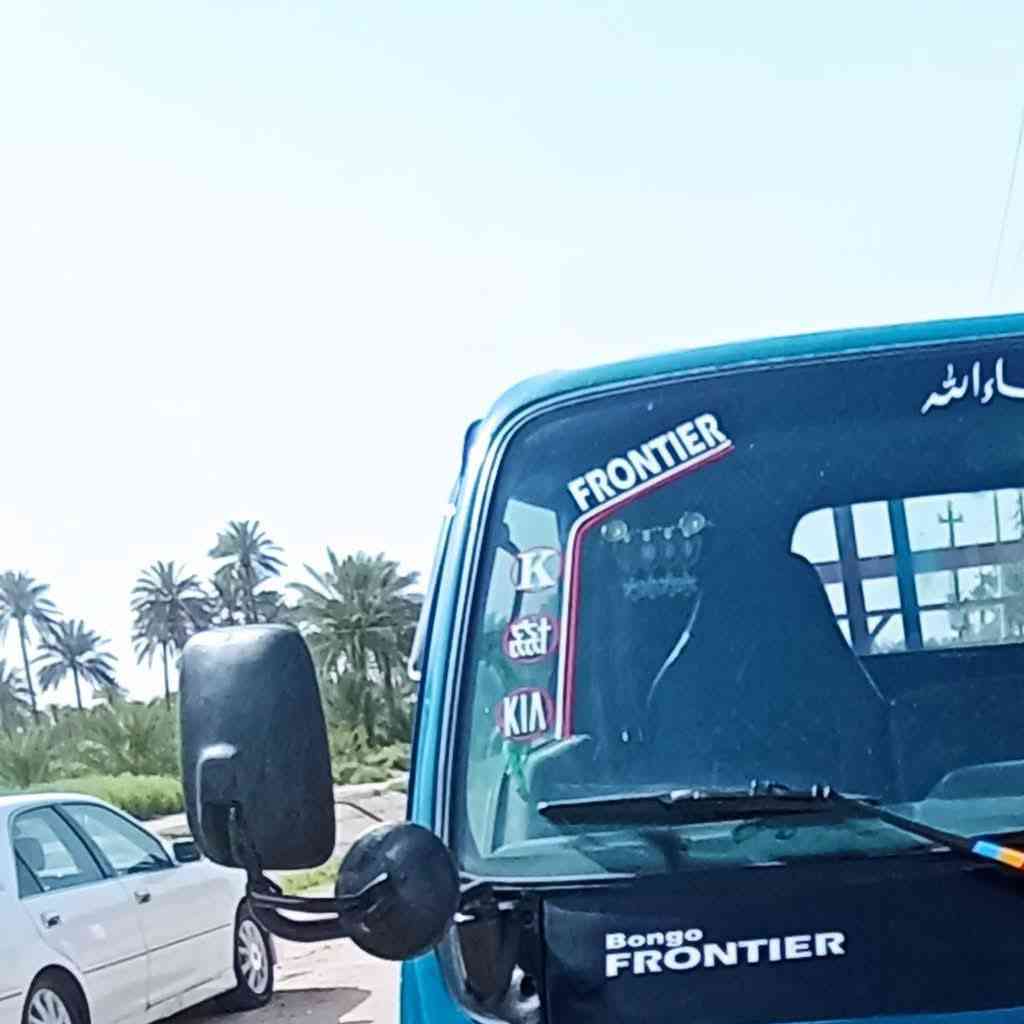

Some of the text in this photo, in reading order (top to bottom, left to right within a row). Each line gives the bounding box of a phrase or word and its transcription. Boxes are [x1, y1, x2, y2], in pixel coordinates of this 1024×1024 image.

[567, 413, 730, 512] FRONTIER
[502, 691, 549, 737] KIA
[605, 928, 703, 949] Bongo
[605, 932, 846, 977] FRONTIER
